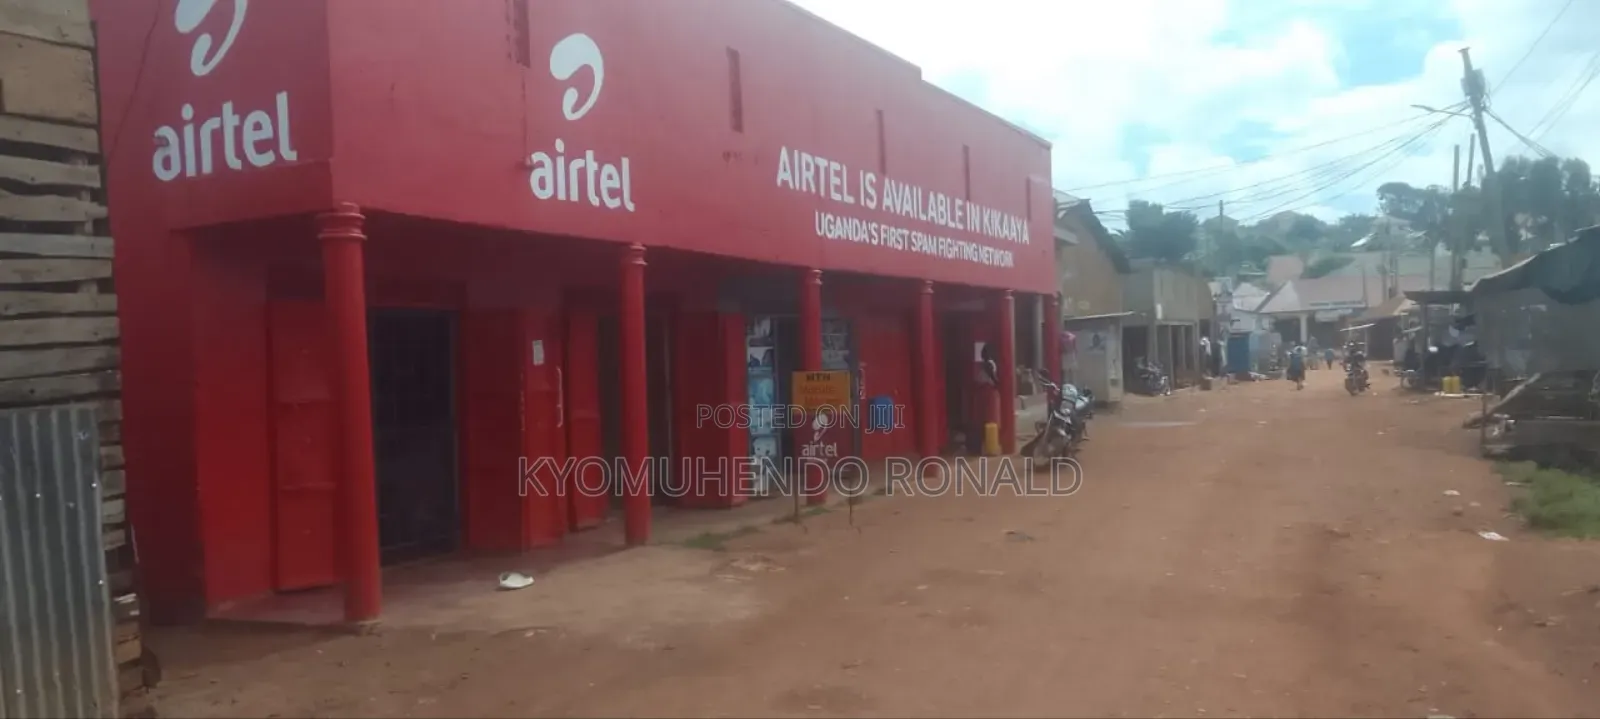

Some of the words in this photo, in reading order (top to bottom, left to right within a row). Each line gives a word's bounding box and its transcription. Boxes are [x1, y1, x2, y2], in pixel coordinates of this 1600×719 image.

[152, 91, 298, 182] airtel
[529, 139, 635, 212] airtel
[776, 145, 855, 204] AIRTEL
[860, 169, 877, 210] IS
[882, 178, 963, 230] AVAILABLE
[966, 200, 980, 233] IN
[983, 206, 1029, 244] KIKAAYA
[815, 209, 878, 246] UGANDA'S
[880, 224, 909, 250] FIRST
[911, 230, 937, 257] SPAM
[938, 236, 978, 262] FIGHTING
[979, 245, 1014, 267] NETWORK
[801, 440, 838, 457] airtel
